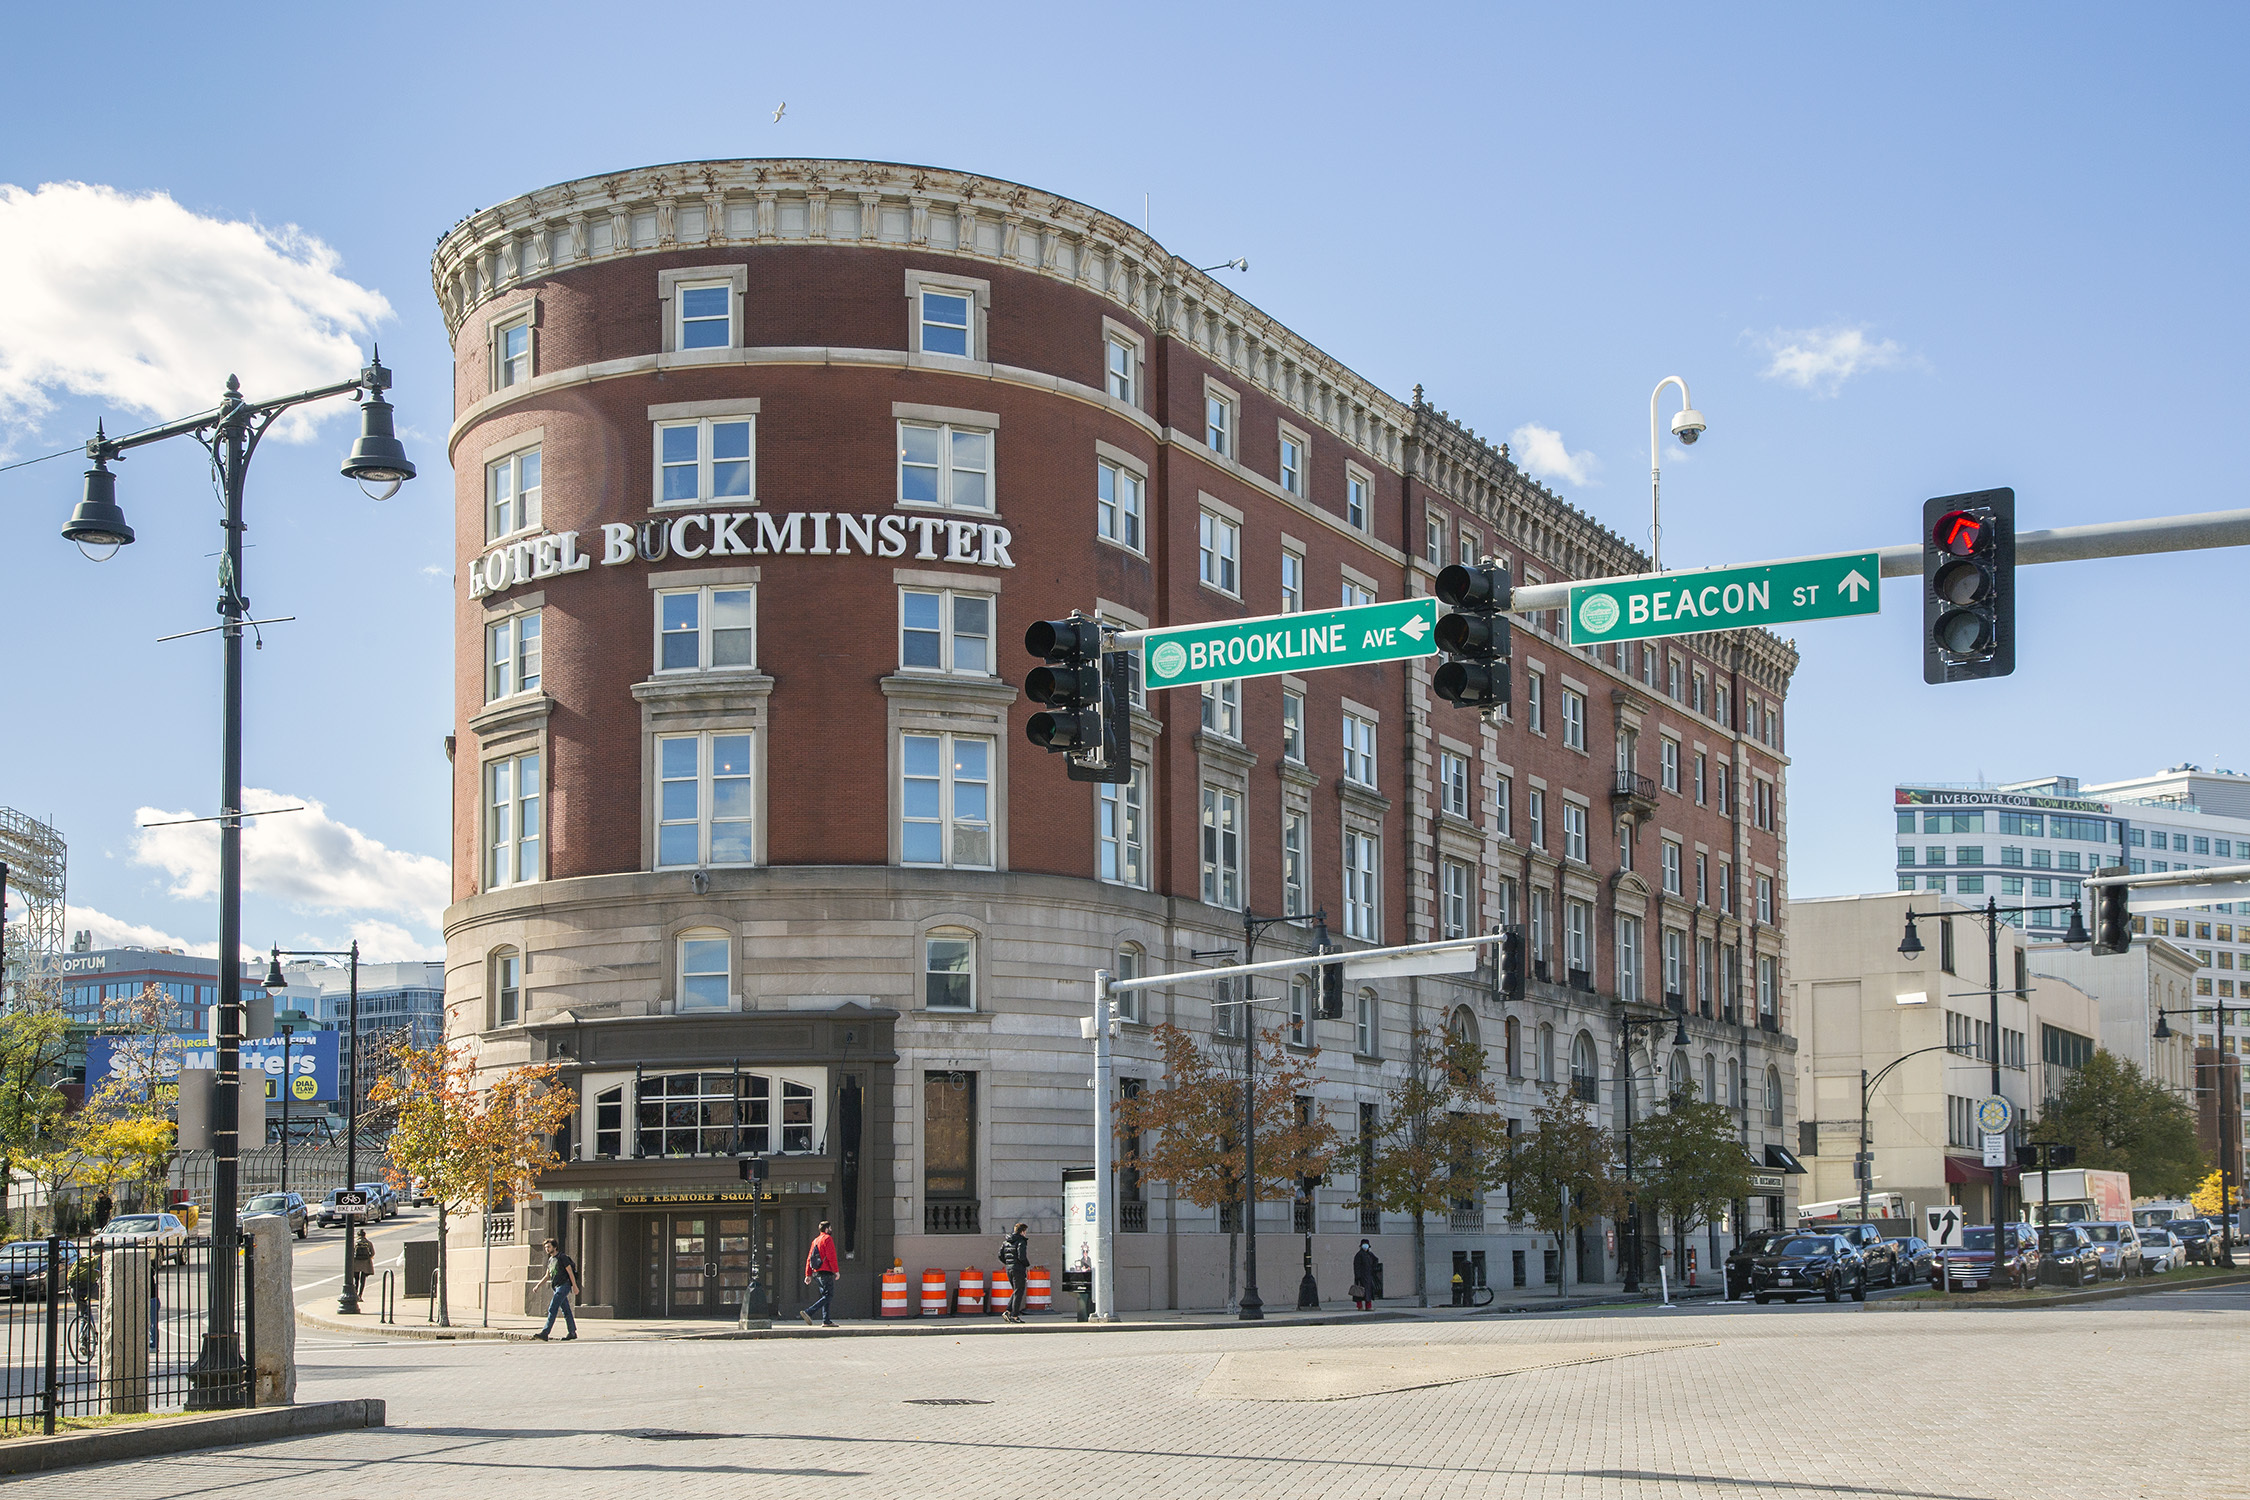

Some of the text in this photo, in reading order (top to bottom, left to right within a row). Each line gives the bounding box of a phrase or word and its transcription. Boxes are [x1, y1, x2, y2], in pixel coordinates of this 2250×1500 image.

[468, 512, 1016, 600] HOTEL BUCKMINSTER
[1629, 580, 1770, 625] BEACON
[1792, 585, 1819, 607] ST
[1190, 623, 1347, 670] BROOKLINE
[1361, 627, 1397, 649] AVE
[1932, 793, 2101, 813] LIVEBOWER.COM NOW LEASING
[63, 956, 106, 971] OPTUM
[172, 1038, 213, 1048] LARGE
[263, 1036, 285, 1046] LAW
[185, 1051, 317, 1075] Mtters
[623, 1192, 772, 1203] ONE KENMORE SQUAE
[1798, 1210, 1813, 1218] UL
